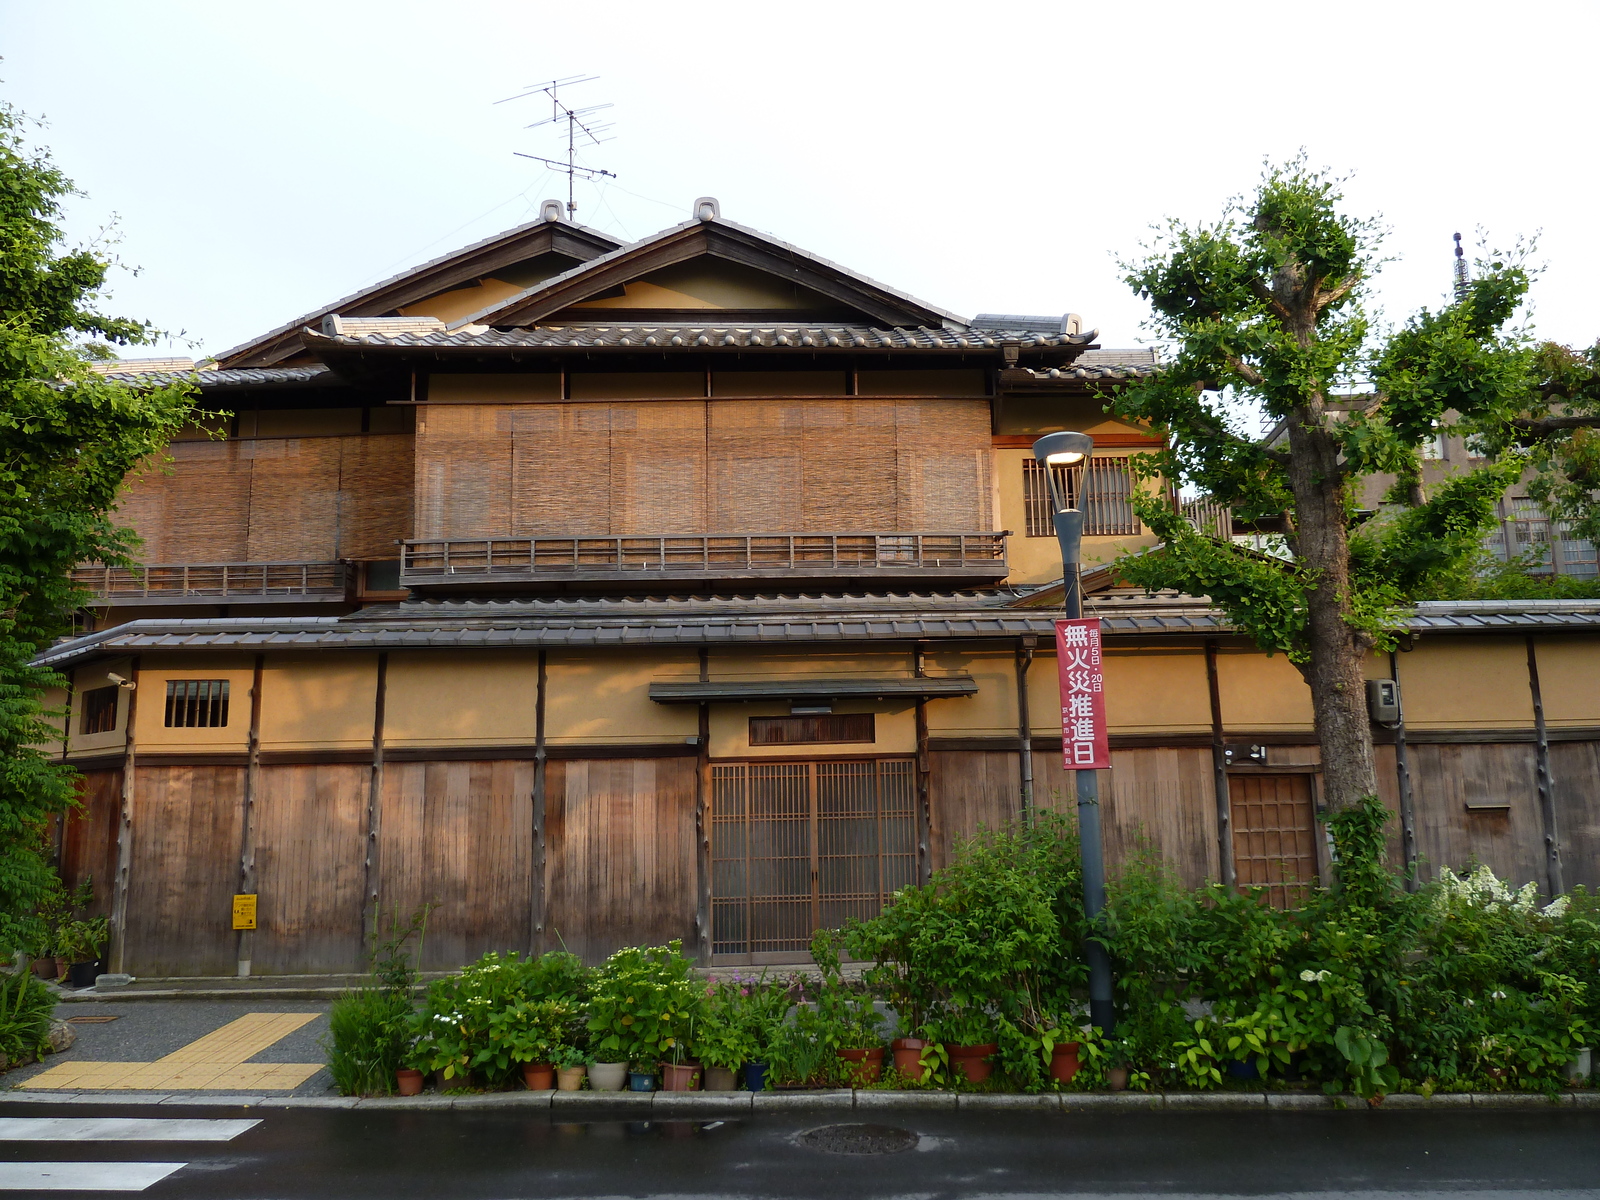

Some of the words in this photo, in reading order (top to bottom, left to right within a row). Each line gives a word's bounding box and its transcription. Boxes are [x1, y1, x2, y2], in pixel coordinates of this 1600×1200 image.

[1065, 625, 1095, 764] 無火災推進日
